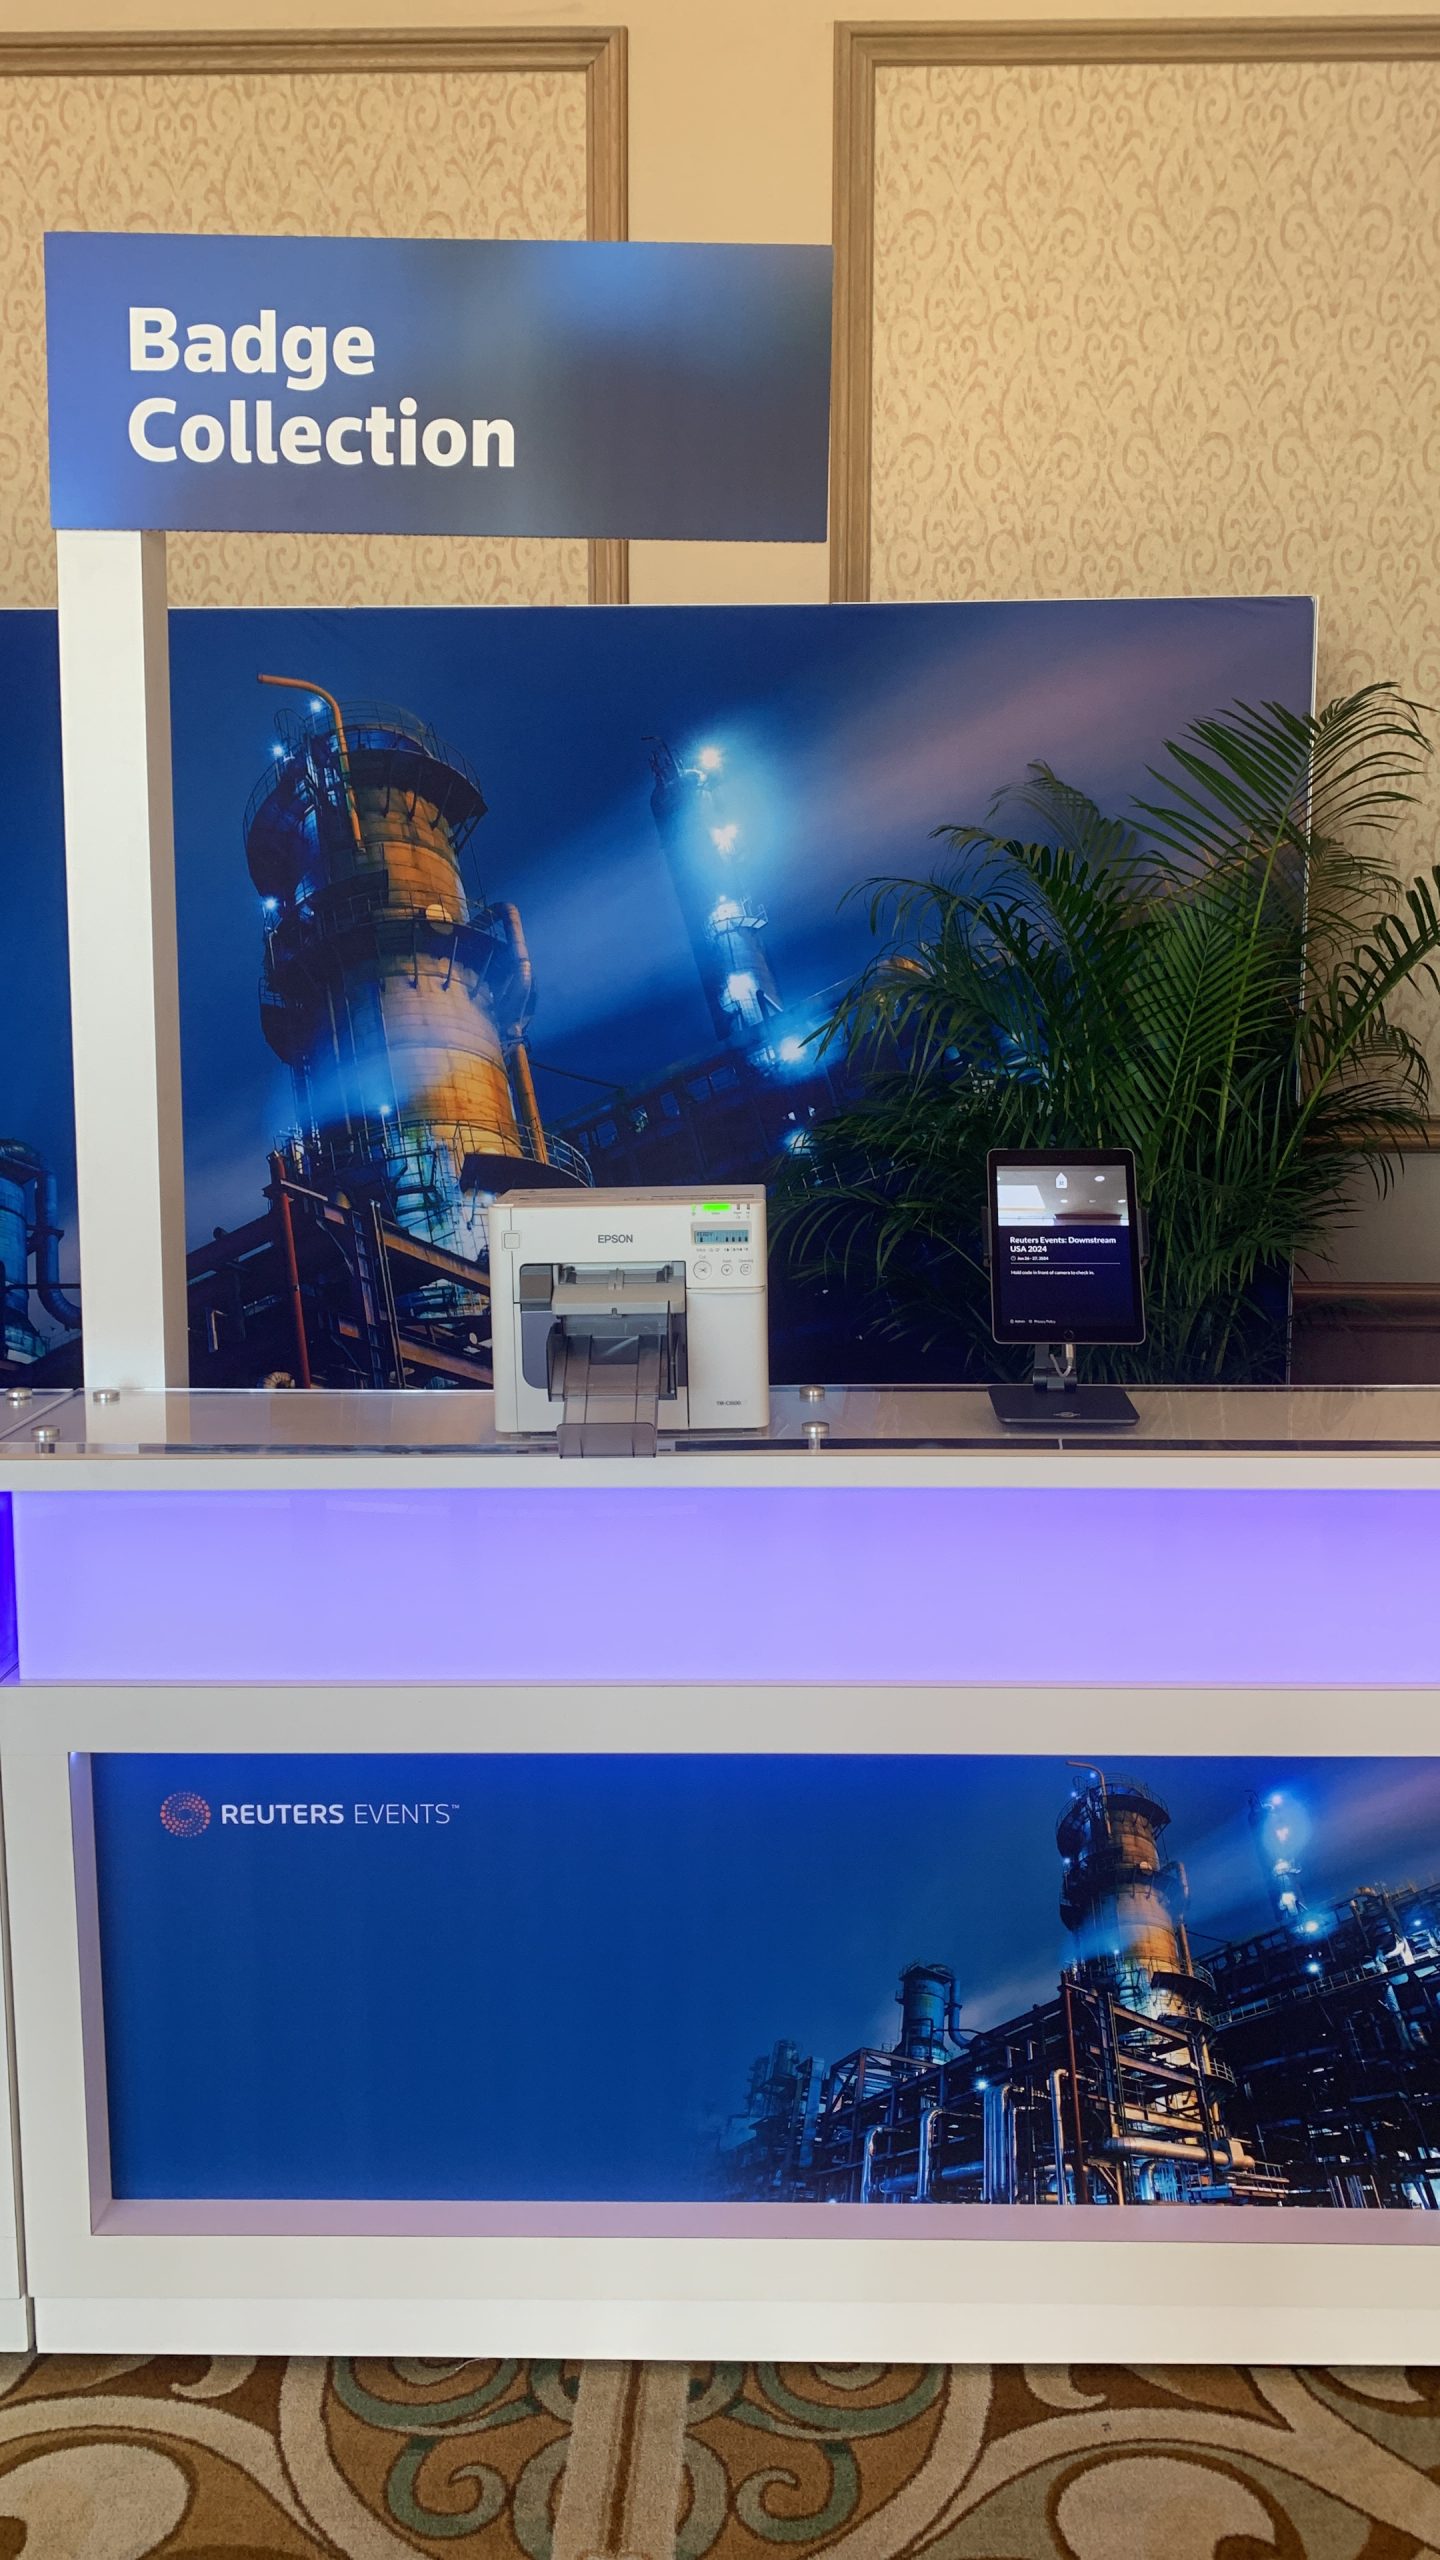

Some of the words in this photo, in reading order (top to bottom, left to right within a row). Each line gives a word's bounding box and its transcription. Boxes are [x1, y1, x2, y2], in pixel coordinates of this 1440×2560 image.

[129, 307, 375, 390] Badge
[128, 397, 515, 467] Collection
[597, 1234, 633, 1244] EPSON
[1010, 1236, 1039, 1244] Reuters
[1040, 1236, 1067, 1244] Events:
[1068, 1236, 1117, 1244] Downstream
[1010, 1245, 1027, 1253] USA
[1027, 1245, 1047, 1253] 2024
[221, 1804, 345, 1824] REUTERS
